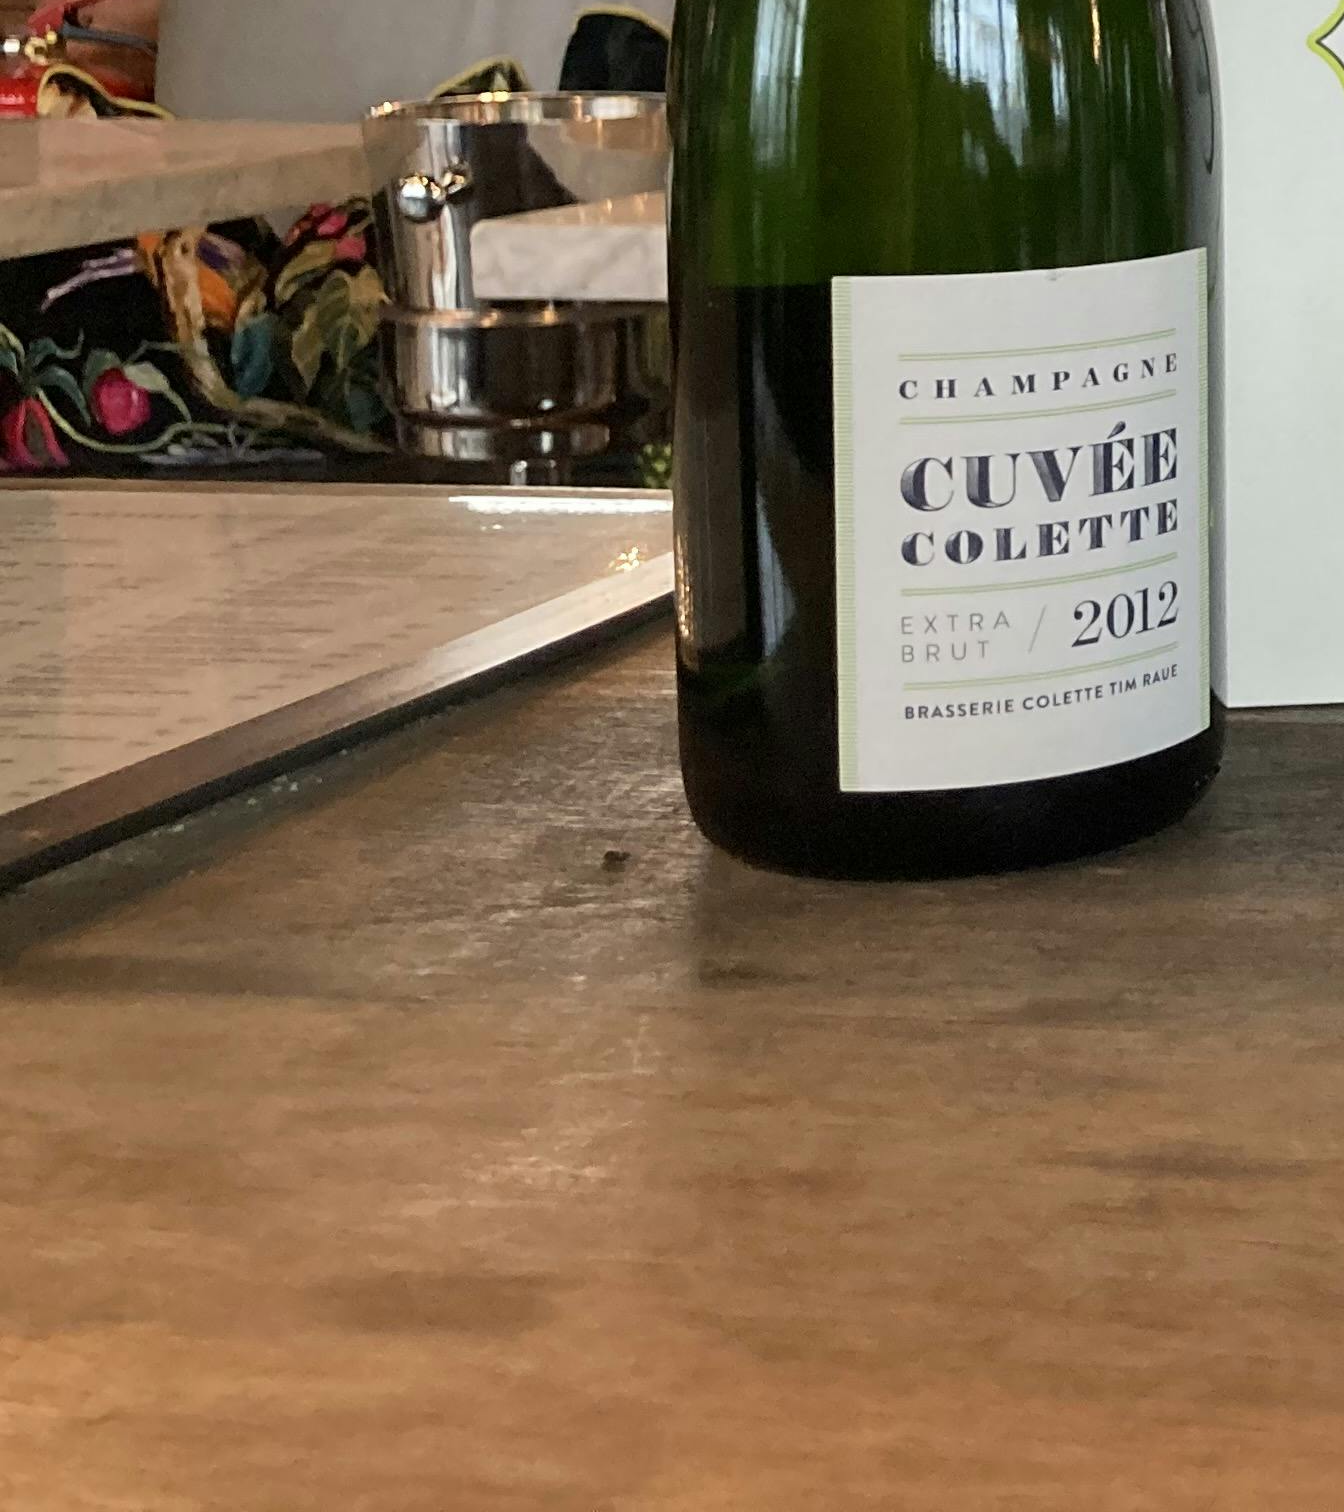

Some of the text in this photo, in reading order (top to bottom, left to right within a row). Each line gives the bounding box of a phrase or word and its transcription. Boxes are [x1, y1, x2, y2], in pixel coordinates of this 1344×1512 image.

[898, 352, 1178, 400] CHAMPAGNE
[899, 419, 1179, 512] CUVÉE
[900, 497, 1179, 567] COLETTE
[900, 580, 1180, 649] EXTRA 2012
[900, 639, 991, 664] BRUT
[904, 663, 1179, 721] BRASSERIE COLETTE TIM RAUE
